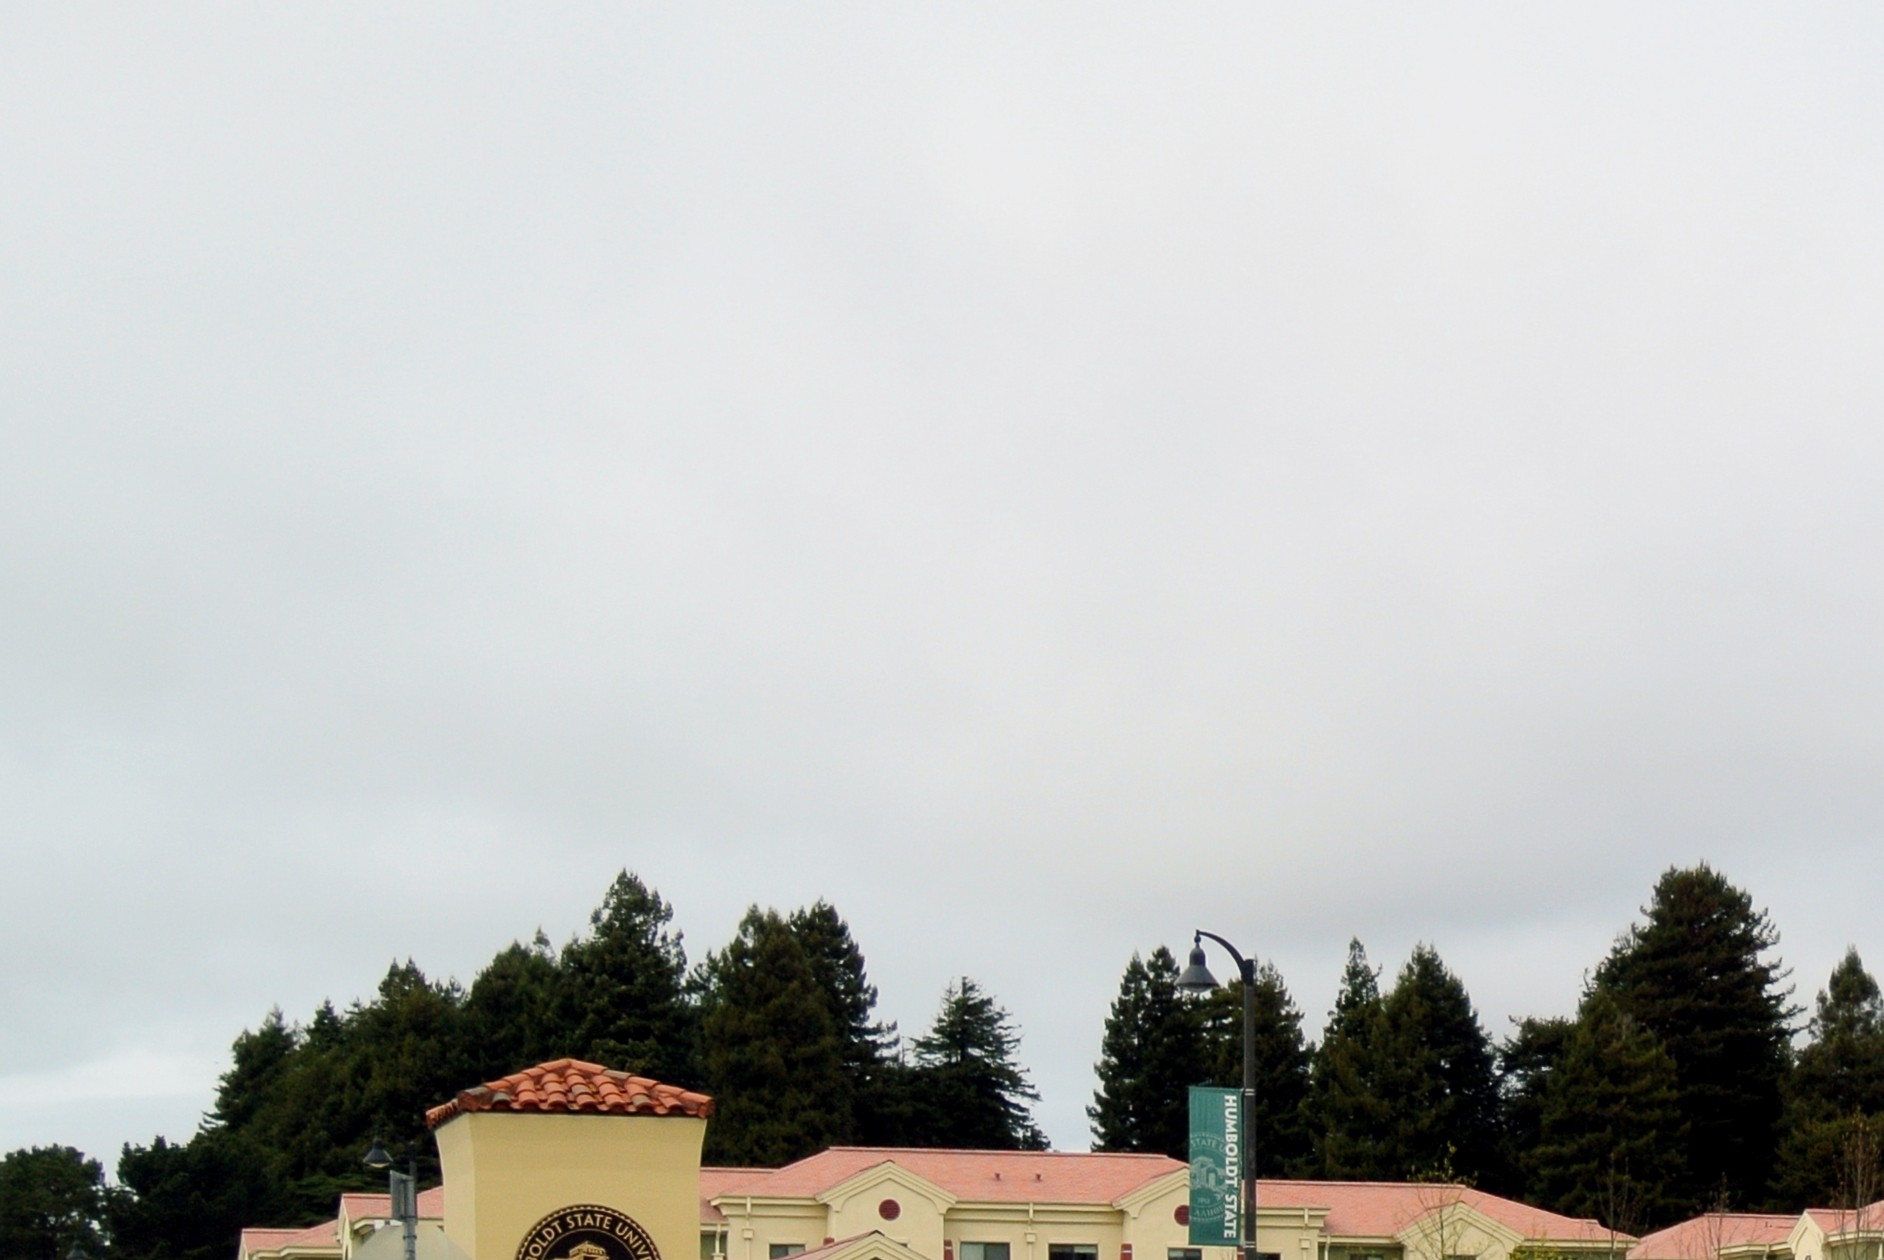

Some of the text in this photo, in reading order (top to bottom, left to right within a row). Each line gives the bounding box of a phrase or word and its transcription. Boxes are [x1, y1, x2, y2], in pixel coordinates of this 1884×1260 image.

[1224, 1095, 1238, 1238] HUMBOLDT STATE
[566, 1213, 613, 1230] STATE
